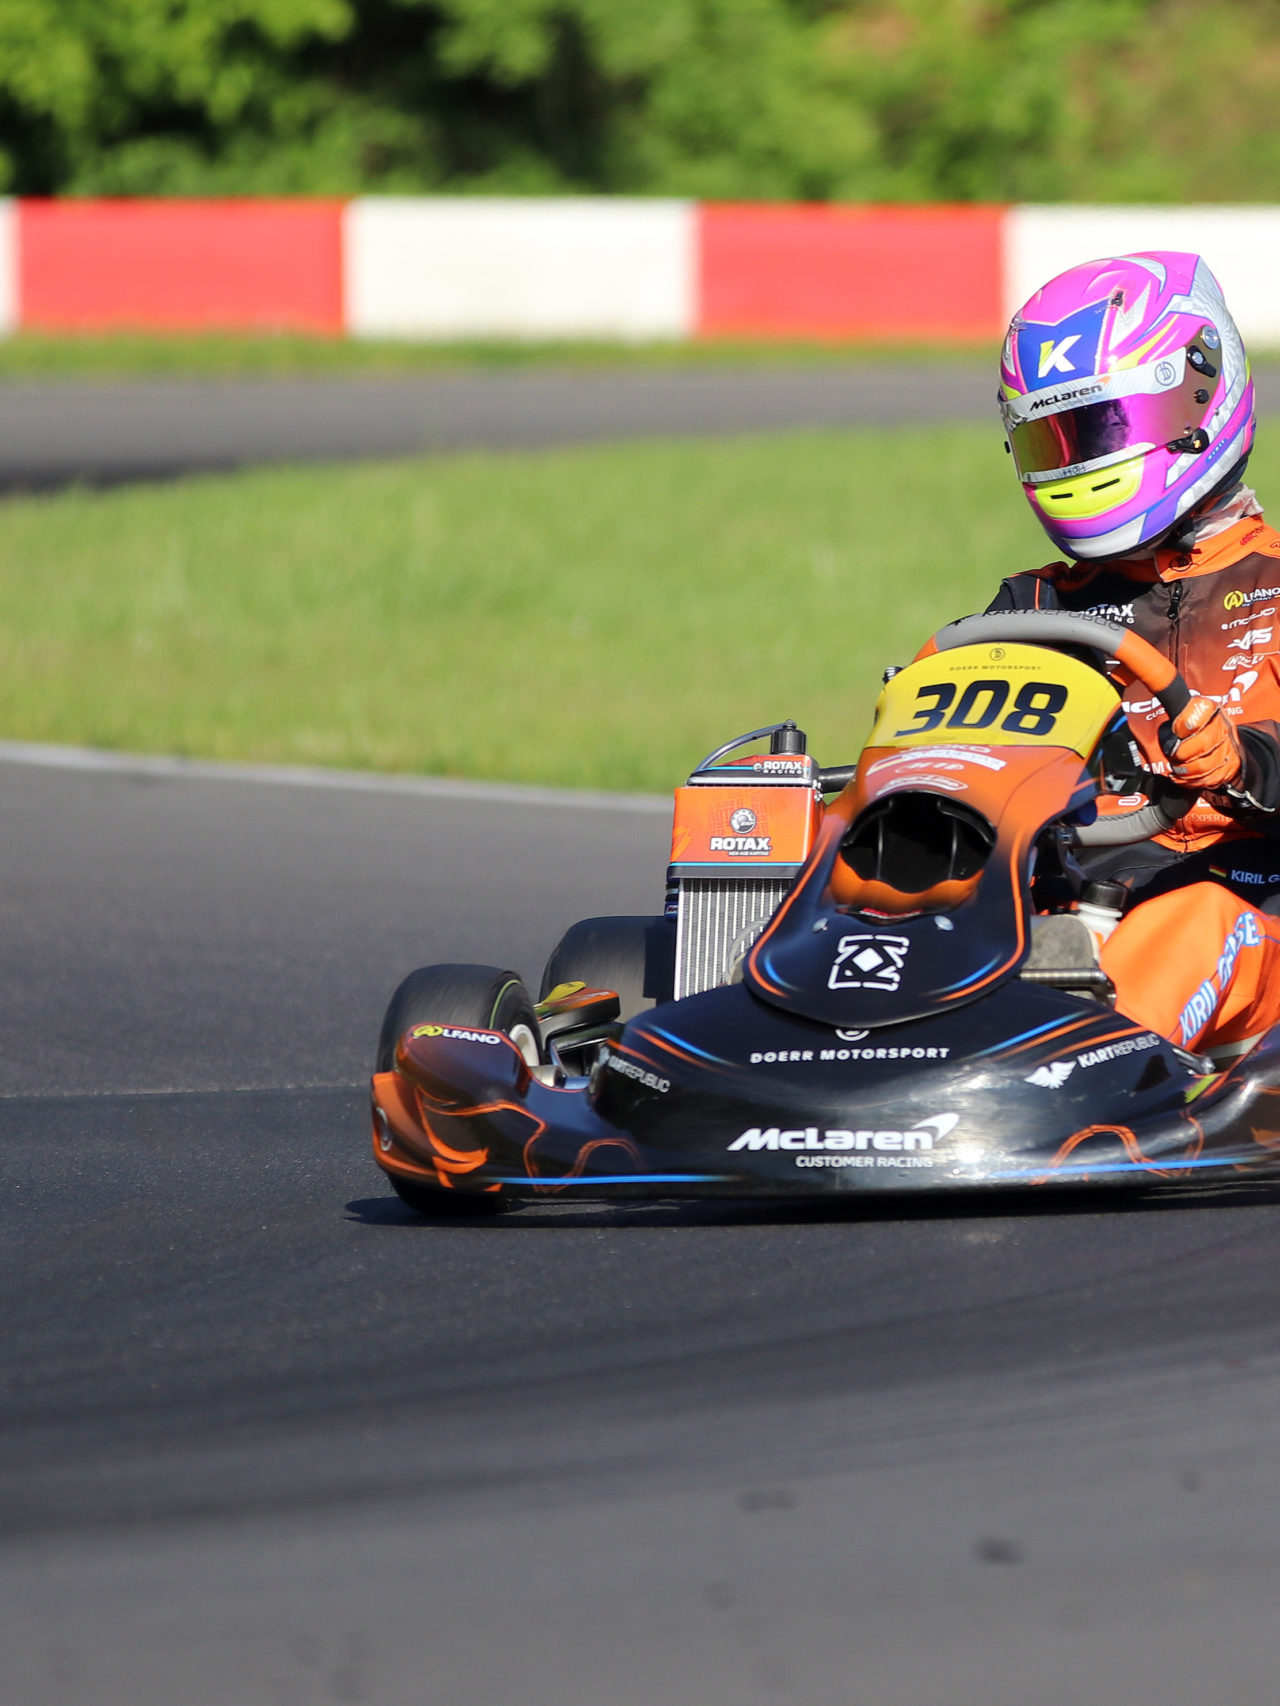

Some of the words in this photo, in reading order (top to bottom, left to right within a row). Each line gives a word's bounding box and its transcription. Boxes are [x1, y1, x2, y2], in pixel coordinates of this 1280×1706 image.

[1029, 384, 1103, 411] McLaren
[1079, 603, 1134, 617] OTAX
[894, 679, 1069, 737] 308
[763, 761, 802, 770] ROTAX
[710, 837, 770, 851] ROTAX
[1231, 869, 1266, 885] KIRIL
[1179, 979, 1218, 1047] KIRIL
[413, 1024, 501, 1045] ALFANO
[750, 1050, 814, 1063] DOERR
[820, 1047, 950, 1061] MOTORSPORT
[1077, 1034, 1160, 1069] KARTREPUBLIC
[727, 1126, 934, 1151] McLaren
[795, 1155, 875, 1168] CUSTOMER
[877, 1155, 934, 1168] RACING
